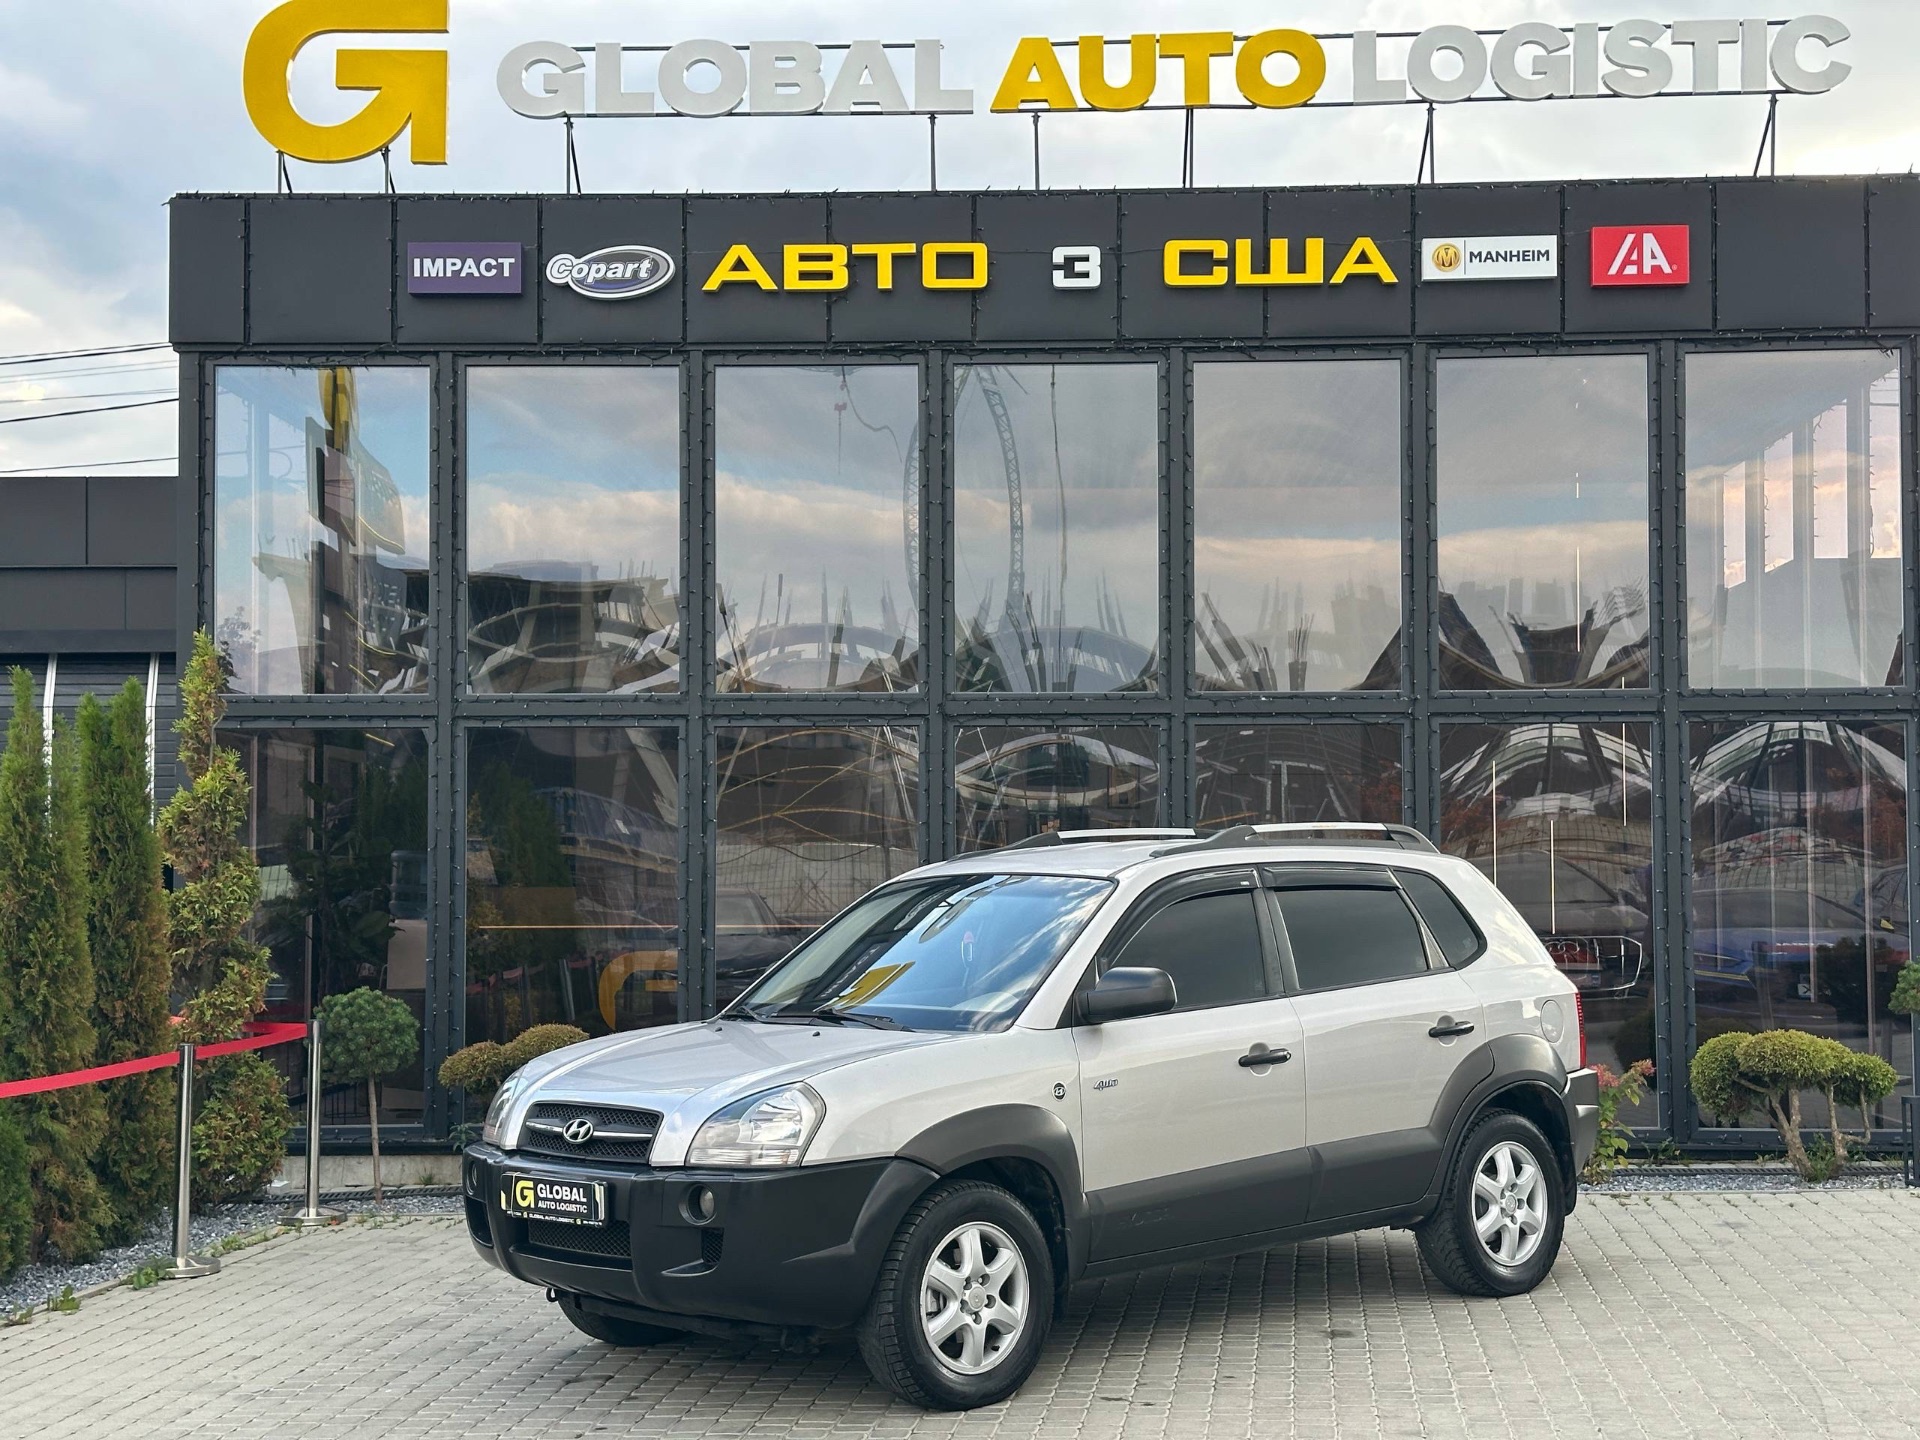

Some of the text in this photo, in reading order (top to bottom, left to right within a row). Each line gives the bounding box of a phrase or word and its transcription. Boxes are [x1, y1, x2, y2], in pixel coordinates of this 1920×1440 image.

[496, 37, 974, 120] GLOBAL
[990, 29, 1327, 113] AUTO
[1353, 15, 1852, 105] LOGISTIC
[701, 242, 989, 292] АВТО
[1163, 236, 1399, 287] США
[1468, 249, 1550, 264] MANHEIM
[413, 257, 516, 278] IMPACT
[548, 255, 654, 285] Copart
[536, 1183, 588, 1202] GLOBAL
[537, 1200, 588, 1213] AUTO LOGISTIC
